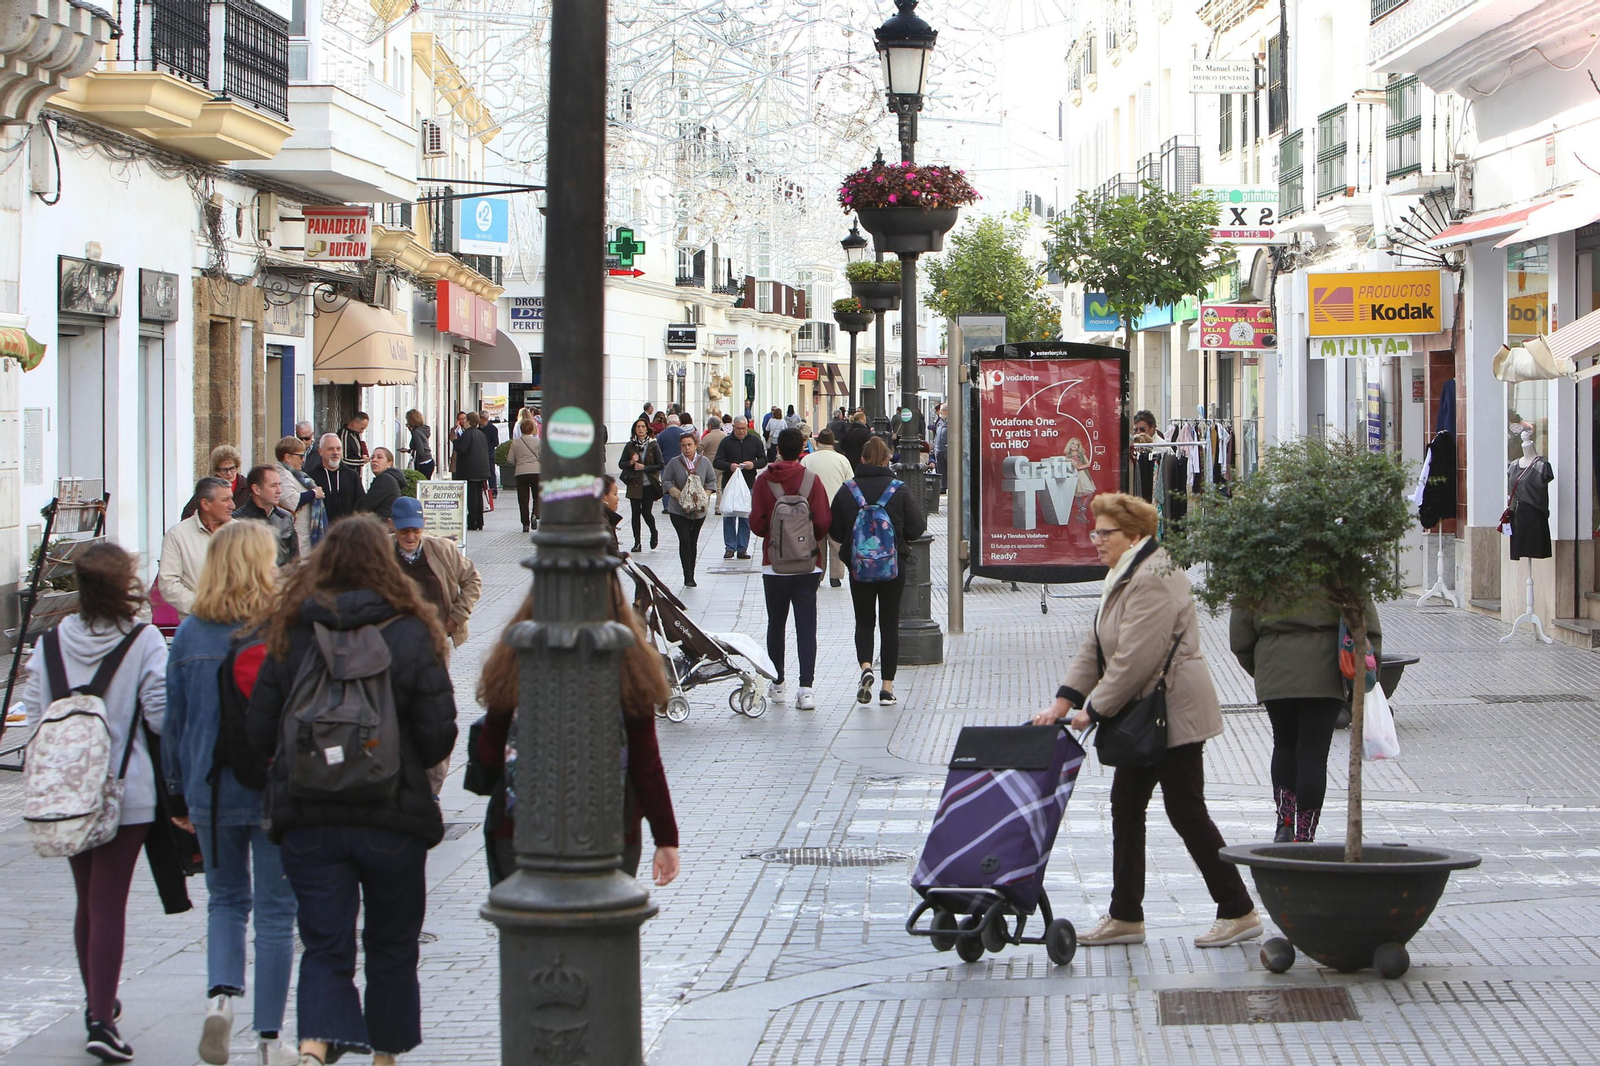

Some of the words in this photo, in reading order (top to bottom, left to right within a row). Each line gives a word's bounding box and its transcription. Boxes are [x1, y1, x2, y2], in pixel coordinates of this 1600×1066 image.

[1192, 64, 1203, 72] Dr.
[1206, 64, 1230, 72] Manuel
[1243, 189, 1279, 204] primitiva
[1229, 207, 1247, 226] X
[1259, 207, 1274, 226] 2
[307, 218, 367, 235] PANADERIA
[328, 241, 367, 257] BUTRON
[1358, 284, 1432, 299] PRODUCTOS
[1371, 302, 1435, 321] Kodak
[513, 322, 543, 330] PERFU
[716, 338, 736, 346] katia
[1321, 338, 1398, 357] MIJITA
[990, 418, 1033, 426] Vodafone
[1035, 418, 1057, 426] One.
[990, 429, 1003, 437] TV
[1005, 429, 1031, 439] gratis
[1040, 429, 1058, 437] año
[990, 441, 1006, 449] con
[1008, 477, 1079, 531] TV
[991, 553, 1017, 561] Ready?
